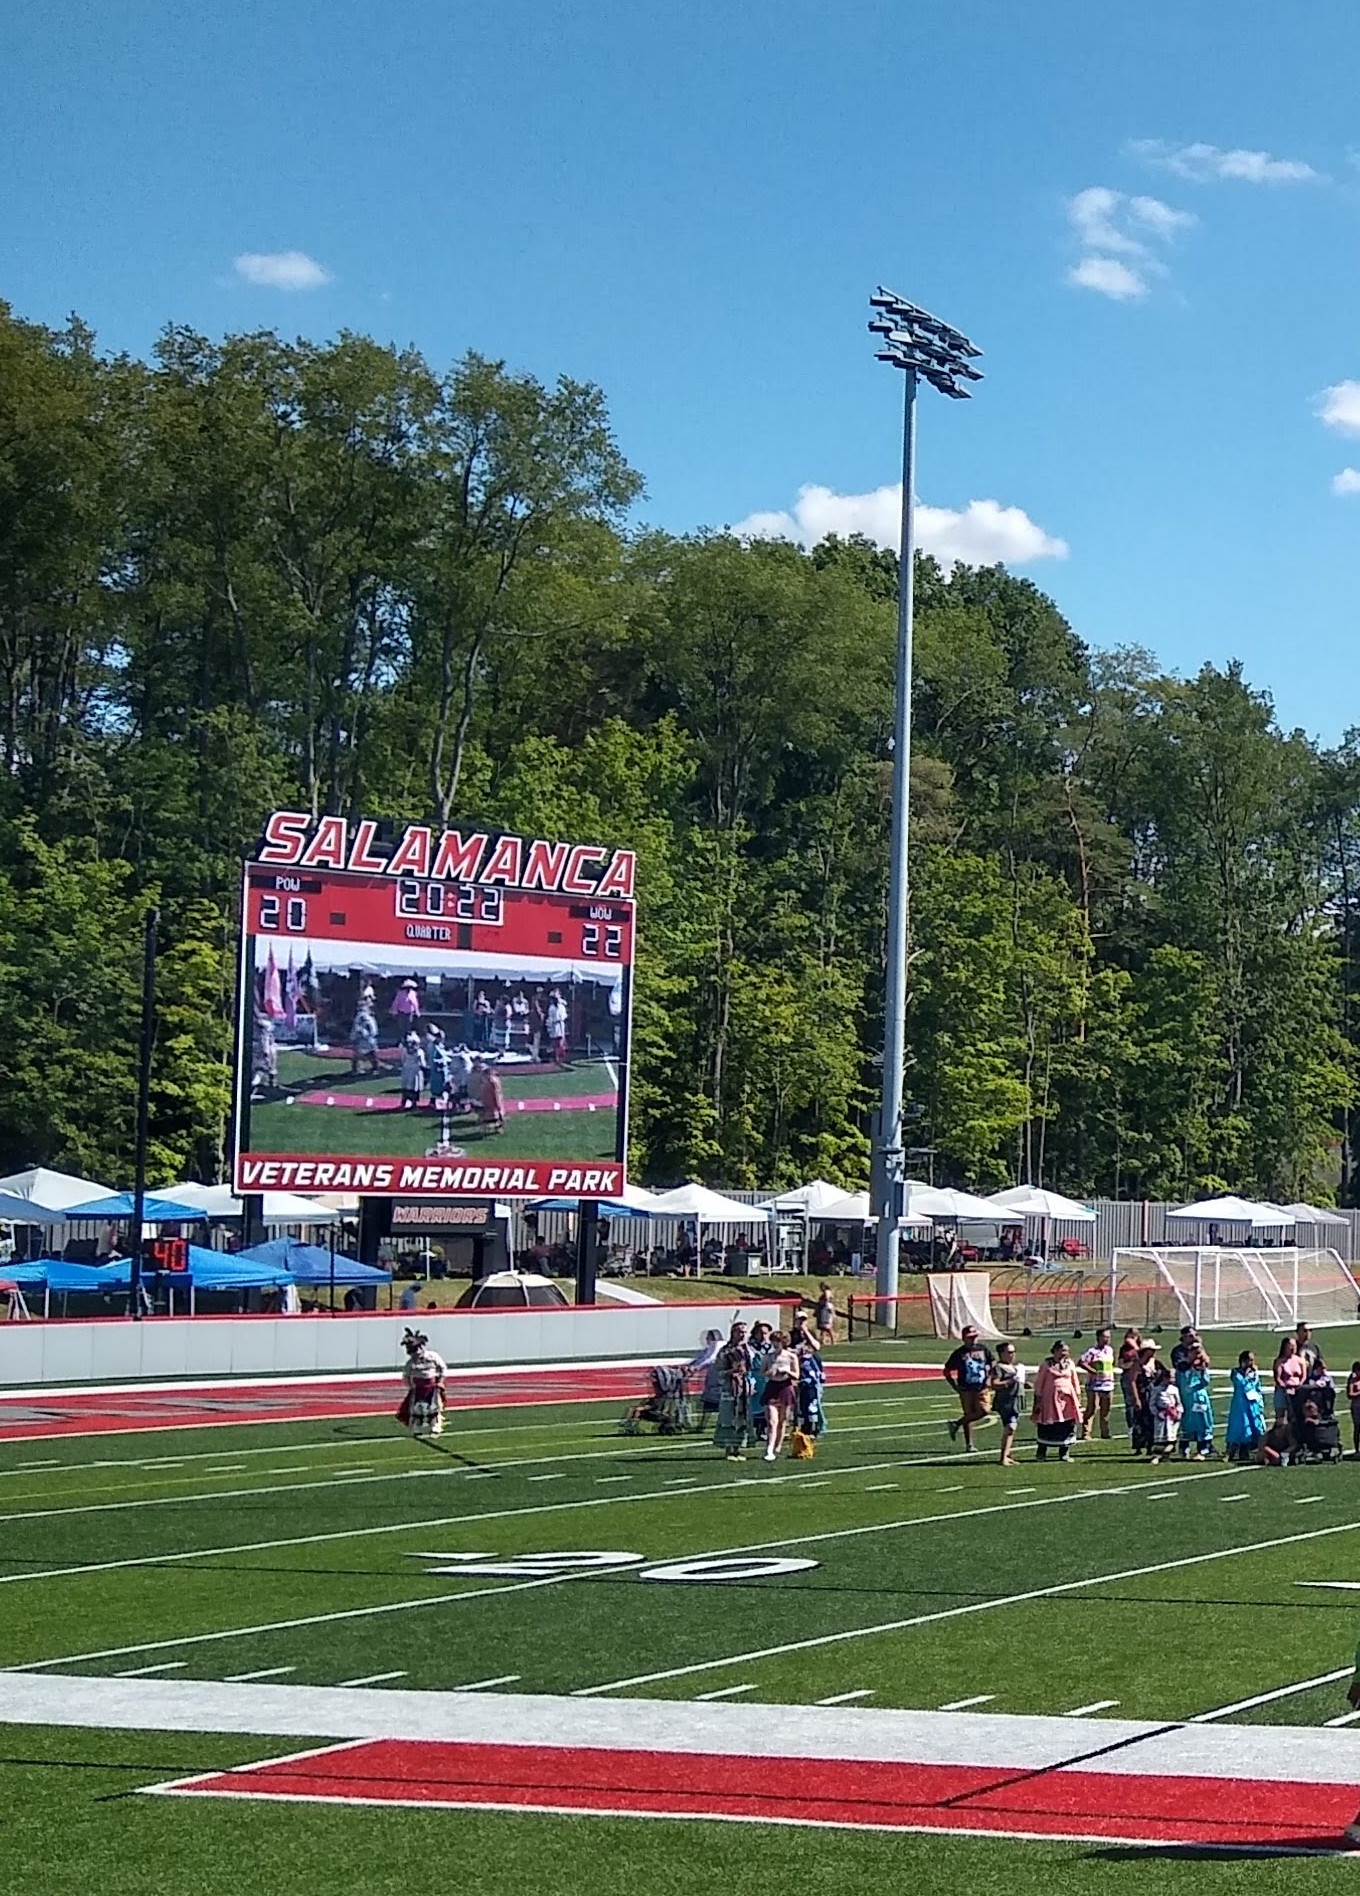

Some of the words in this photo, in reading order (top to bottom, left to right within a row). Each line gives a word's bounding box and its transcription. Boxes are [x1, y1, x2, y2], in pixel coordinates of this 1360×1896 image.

[260, 811, 636, 897] SALAMANCA
[275, 876, 301, 891] POW
[260, 895, 307, 930] 20
[401, 881, 499, 919] 20:22
[590, 905, 613, 919] WOW
[406, 924, 452, 940] QUARTER
[582, 923, 622, 956] 22
[241, 1161, 393, 1188] VETERANS
[400, 1166, 539, 1191] MEMORIAL
[547, 1169, 619, 1192] PARK
[392, 1206, 489, 1224] WARRIORS
[154, 1240, 186, 1270] 40
